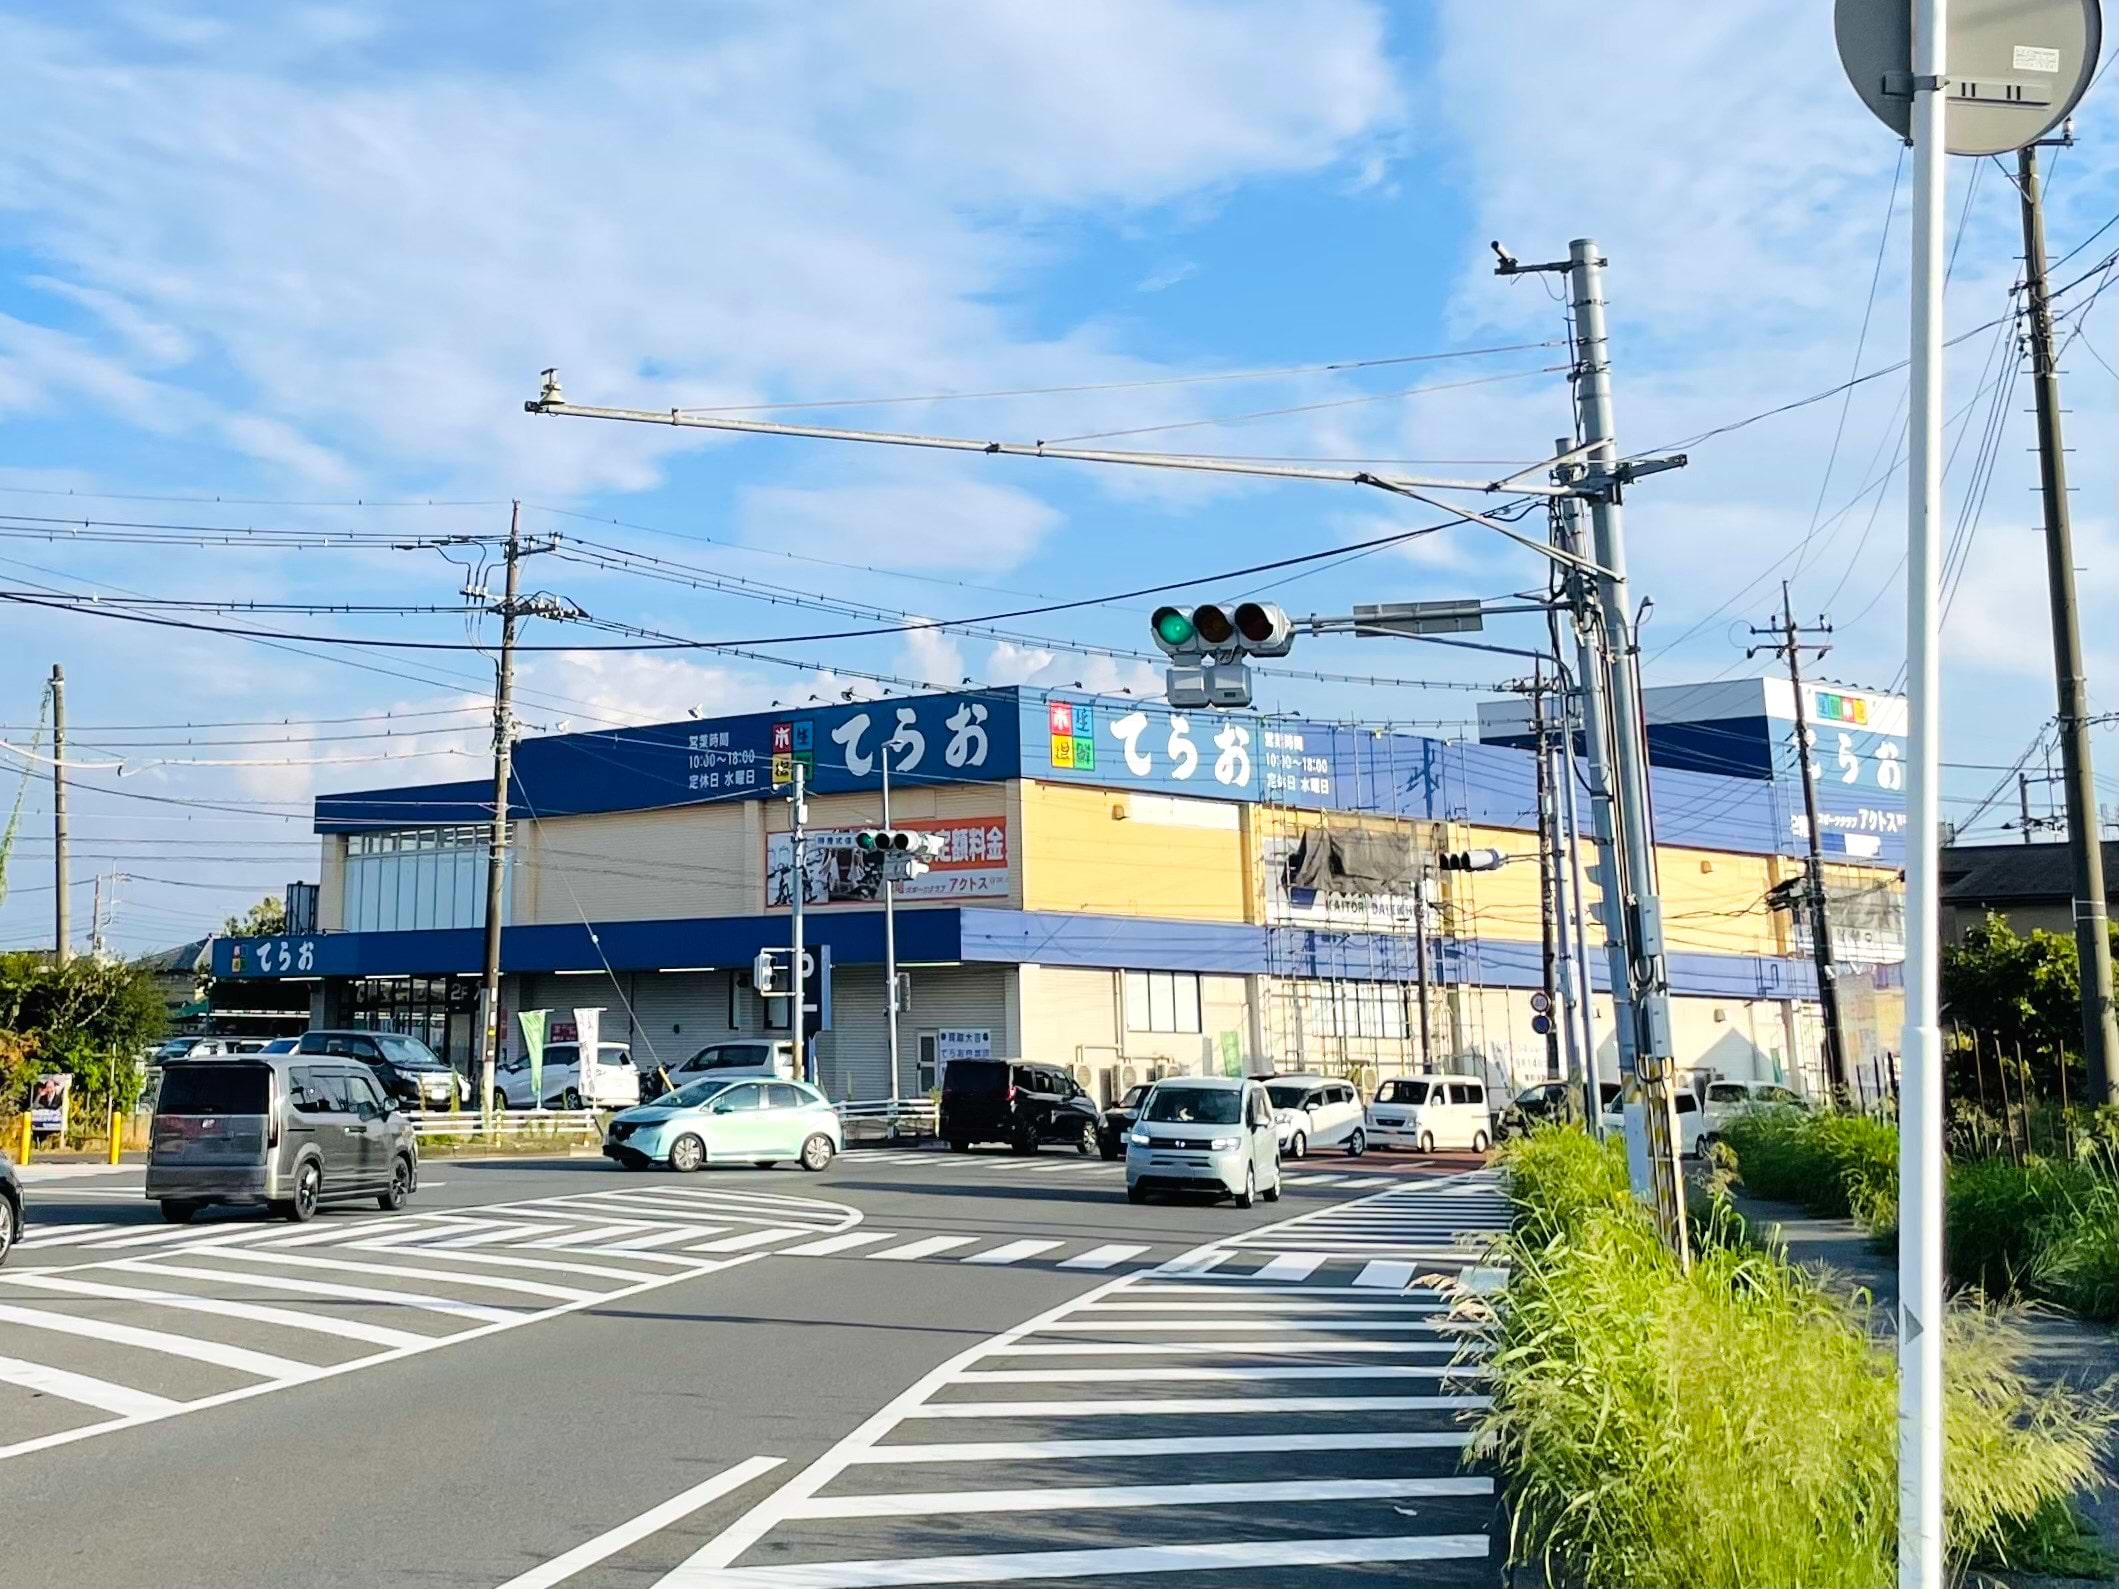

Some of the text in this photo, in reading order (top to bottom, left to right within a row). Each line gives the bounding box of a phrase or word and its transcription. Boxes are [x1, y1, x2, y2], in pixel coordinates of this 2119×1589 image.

[831, 702, 989, 776] てらお
[1110, 710, 1250, 787] てらお
[688, 769, 755, 790] 定休日 水曜日
[1858, 808, 1898, 833] アクトス
[920, 826, 1004, 863] 定額料金
[949, 876, 989, 892] アクトス
[255, 940, 315, 972] てらお
